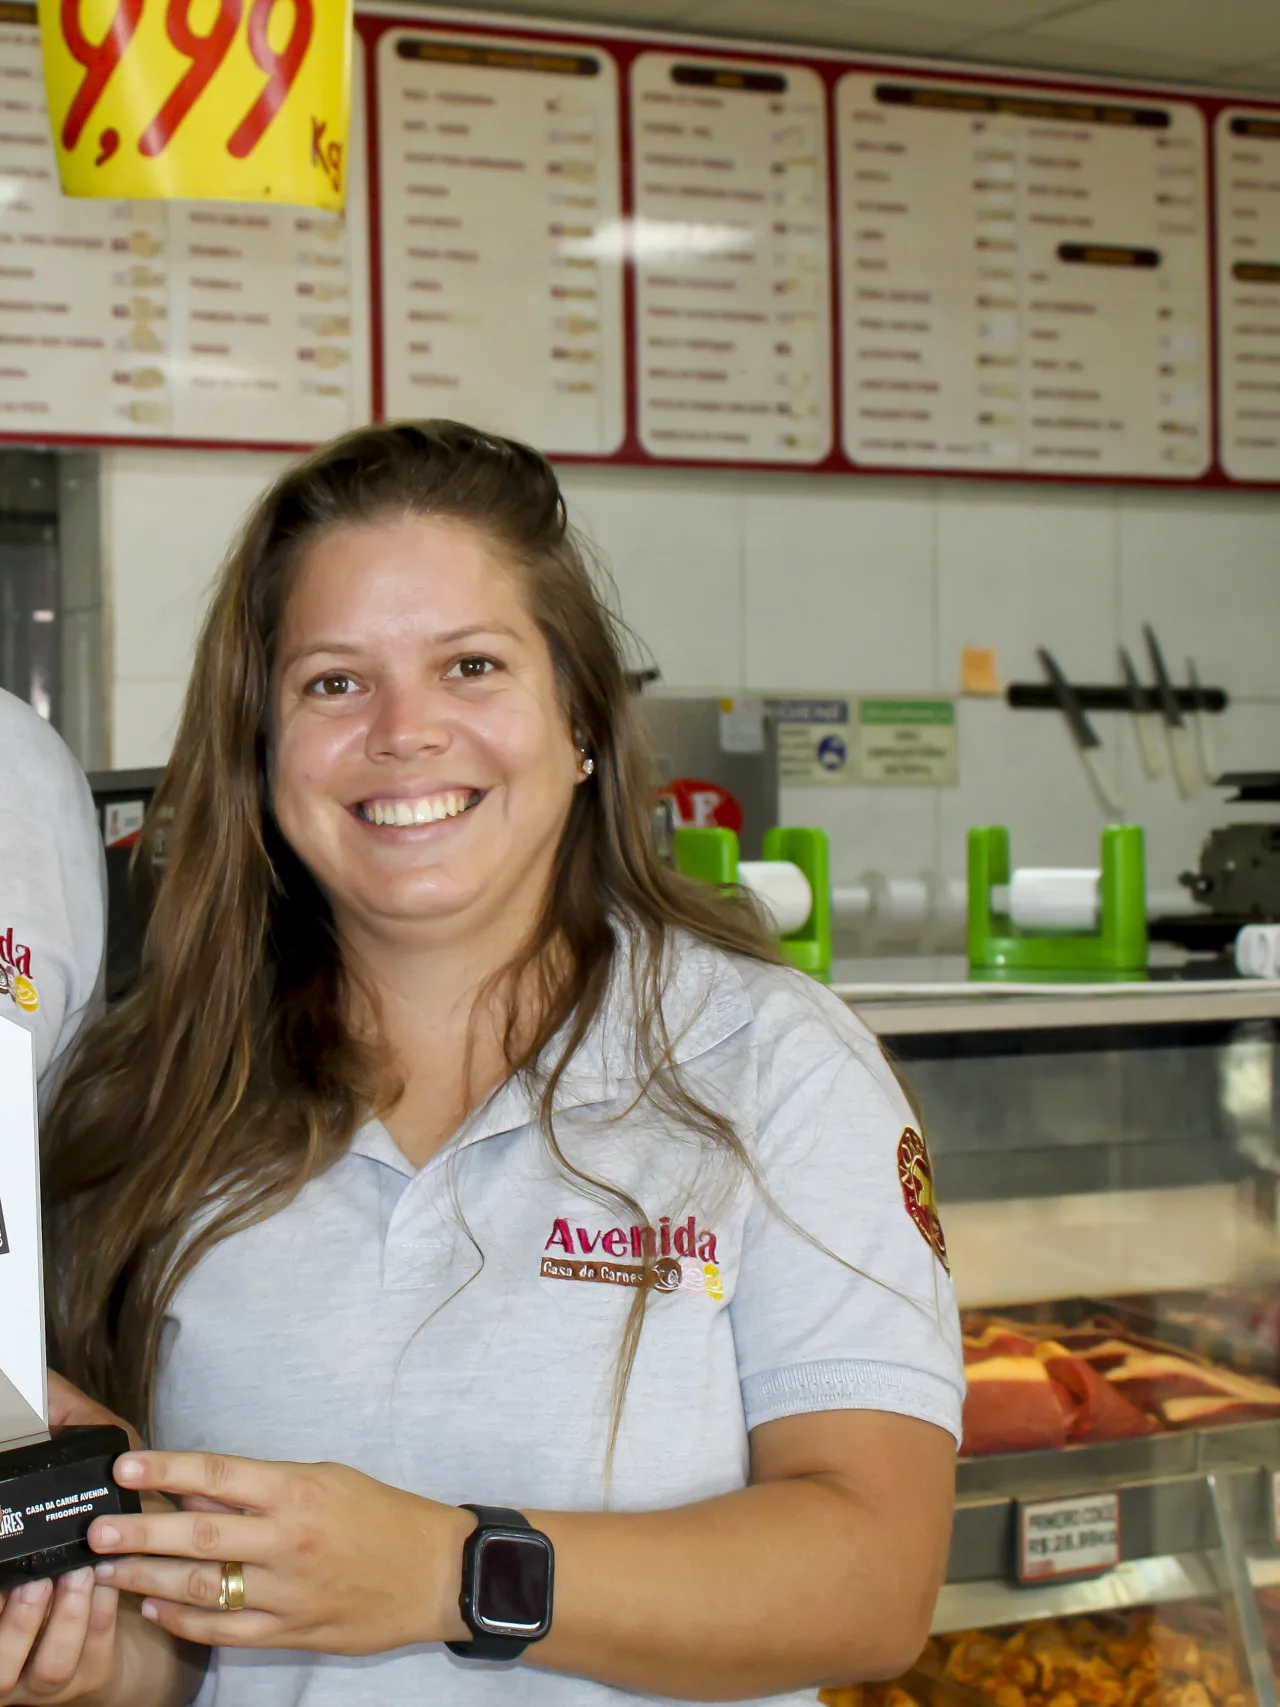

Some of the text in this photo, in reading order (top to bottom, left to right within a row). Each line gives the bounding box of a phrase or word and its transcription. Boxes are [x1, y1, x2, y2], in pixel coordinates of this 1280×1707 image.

[60, 0, 315, 167] 9,99
[311, 114, 343, 194] Kg
[544, 1215, 720, 1265] Avenida
[543, 1261, 644, 1283] Casa de Carnes
[25, 1486, 109, 1516] CASA DA CARNE AVENIDA
[45, 1503, 94, 1522] FRIGORÍFICO
